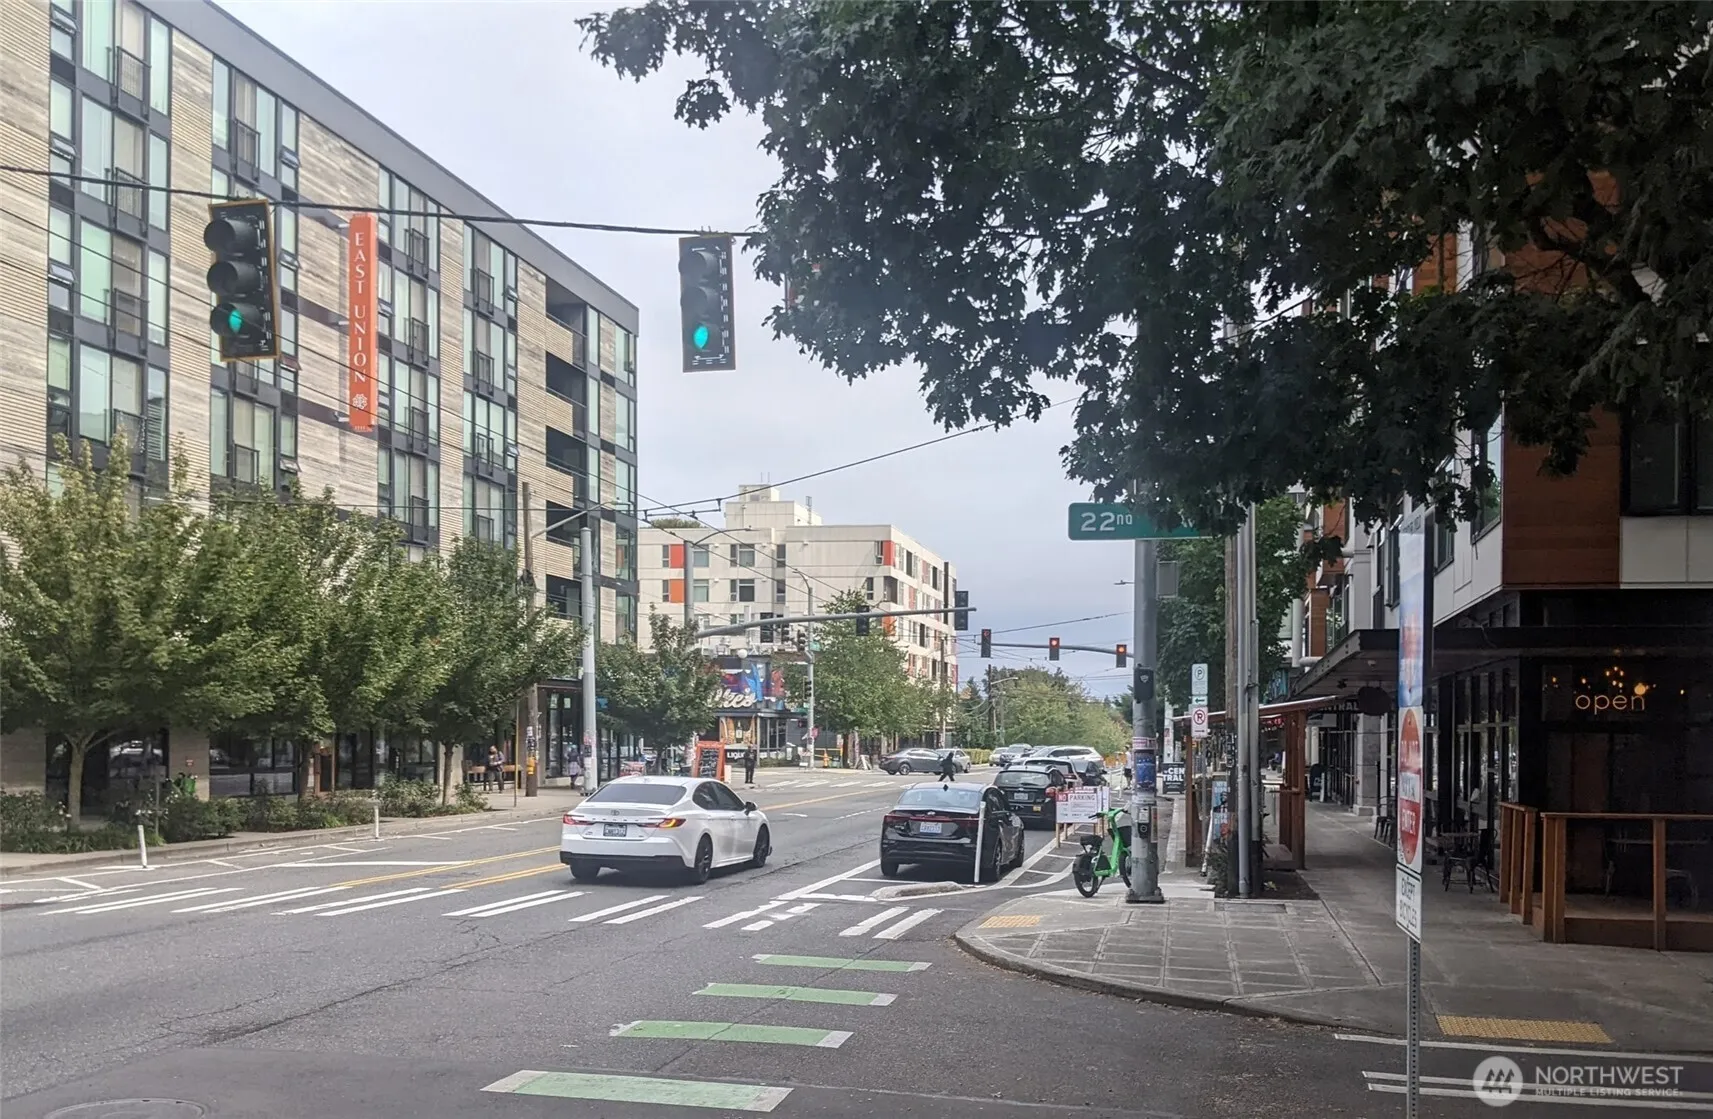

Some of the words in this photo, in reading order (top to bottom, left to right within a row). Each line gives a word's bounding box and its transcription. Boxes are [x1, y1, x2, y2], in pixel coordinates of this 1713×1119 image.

[354, 232, 366, 294] EAST
[354, 305, 366, 383] UNION
[1575, 695, 1645, 715] open
